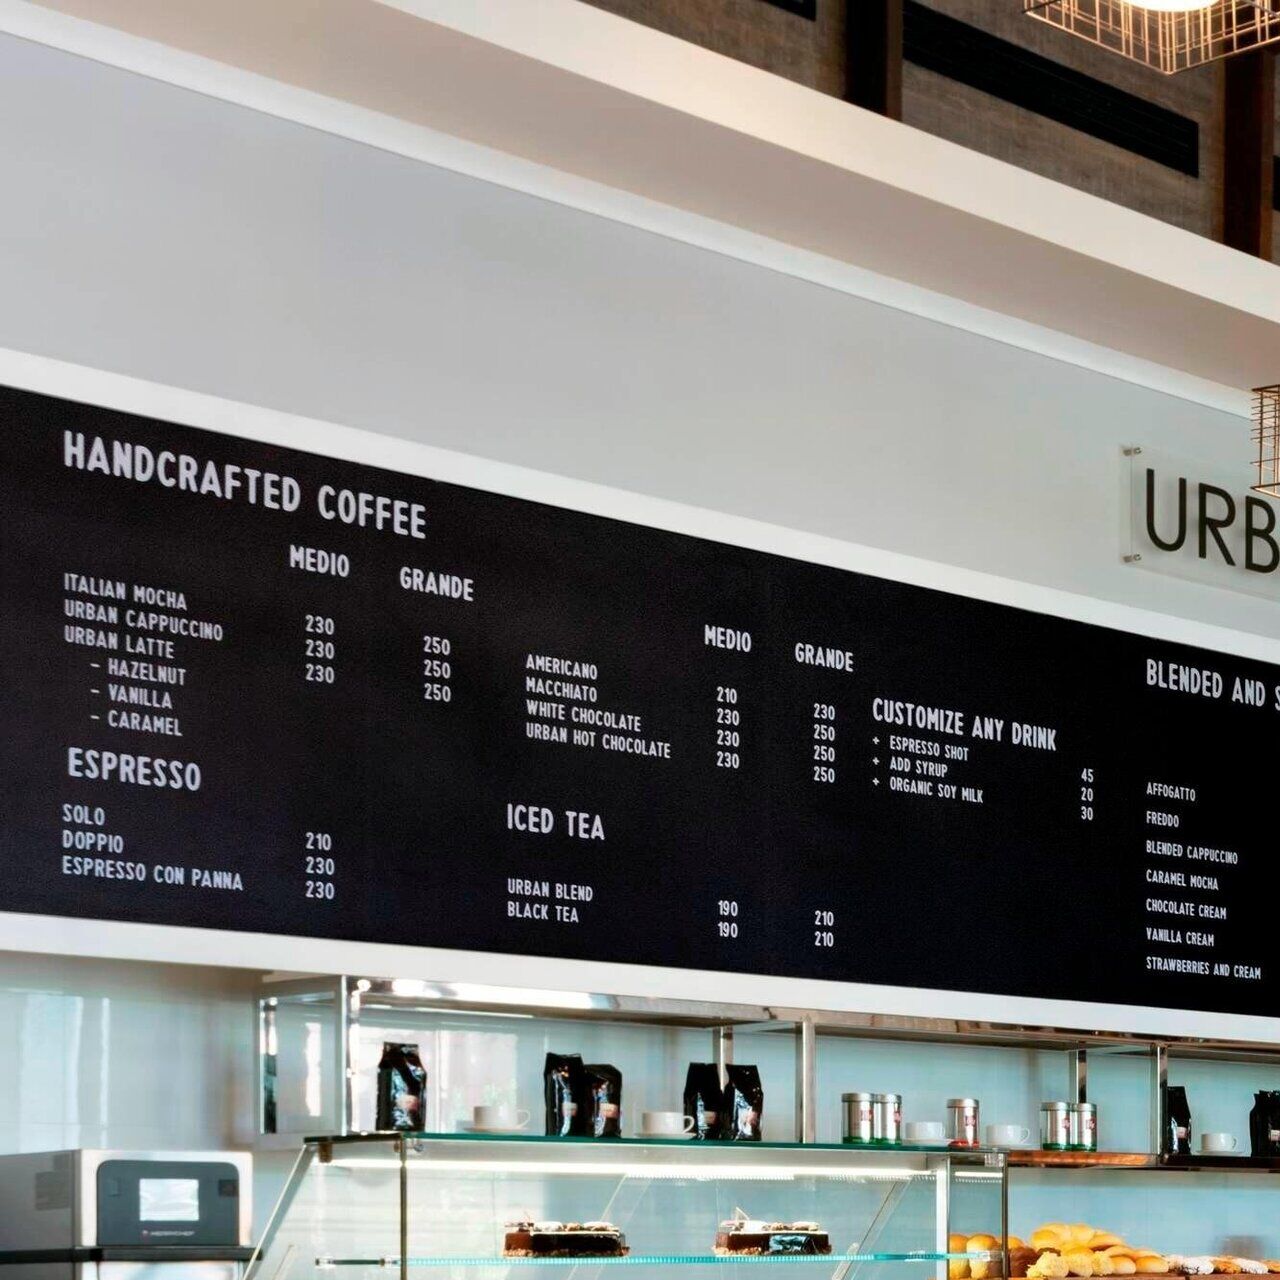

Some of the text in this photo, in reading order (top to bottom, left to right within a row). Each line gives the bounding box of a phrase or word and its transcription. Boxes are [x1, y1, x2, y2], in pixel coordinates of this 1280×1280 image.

[63, 429, 426, 540] HANDCRAFTED COFFEE
[289, 544, 350, 578] MEDIO
[64, 572, 188, 611] ITALIAN MOCHA
[399, 566, 474, 602] GRANDE
[64, 598, 224, 642] URBAN CAPPUCCINO
[305, 614, 335, 636] 230
[64, 624, 175, 659] URBAN LATTE
[305, 638, 335, 660] 230
[423, 635, 451, 656] 250
[704, 624, 752, 653] MEDIO
[423, 658, 451, 679] 250
[525, 653, 598, 680] AMERICANO
[794, 642, 854, 673] GRANDE
[108, 657, 187, 686] HAZELNUT
[305, 663, 335, 684] 230
[1146, 658, 1223, 699] BLENDED
[1231, 676, 1266, 707] AND
[108, 683, 173, 710] VANILLA
[424, 682, 452, 703] 250
[525, 676, 598, 703] MACCHIATO
[716, 686, 738, 704] 210
[526, 698, 642, 733] WHITE CHOCOLATE
[716, 707, 740, 727] 230
[813, 702, 836, 721] 230
[107, 709, 183, 737] CARAMEL
[813, 723, 836, 742] 250
[872, 697, 1057, 752] CUSTOMIZE ANY DRINK
[526, 721, 671, 759] URBAN HOT CHOCOLATE
[716, 729, 740, 748] 230
[889, 734, 969, 761] ESPRESSO SHOT
[716, 750, 740, 769] 230
[813, 744, 836, 763] 250
[67, 746, 202, 792] ESPRESSO
[813, 765, 836, 784] 250
[889, 756, 948, 778] ADD SYRUP
[1080, 767, 1094, 783] 45
[889, 776, 984, 804] ORGANIC SOY MILK
[1080, 786, 1094, 802] 20
[1146, 781, 1196, 802] AFFOGATTO
[62, 803, 106, 826] SOLO
[507, 803, 605, 841] ICED TEA
[1080, 805, 1094, 821] 30
[1146, 810, 1180, 828] FREDDO
[62, 829, 124, 854] DOPPIO
[305, 831, 332, 851] 210
[1146, 839, 1239, 865] BLENDED CAPPUCCINO
[62, 855, 244, 891] ESPRESSO CON PANNA
[305, 855, 335, 876] 230
[305, 880, 335, 900] 230
[507, 877, 594, 902] URBAN BLEND
[1145, 868, 1219, 891] CARAMEL MOCHA
[507, 900, 579, 923] BLACK TEA
[717, 899, 739, 917] 190
[814, 909, 835, 927] 210
[1145, 898, 1227, 920] CHOCOLATE CREAM
[717, 921, 739, 939] 190
[814, 930, 834, 948] 210
[1145, 927, 1215, 947] VANILLA CREAM
[1146, 956, 1262, 980] STRAWBERRIES AND CREAM
